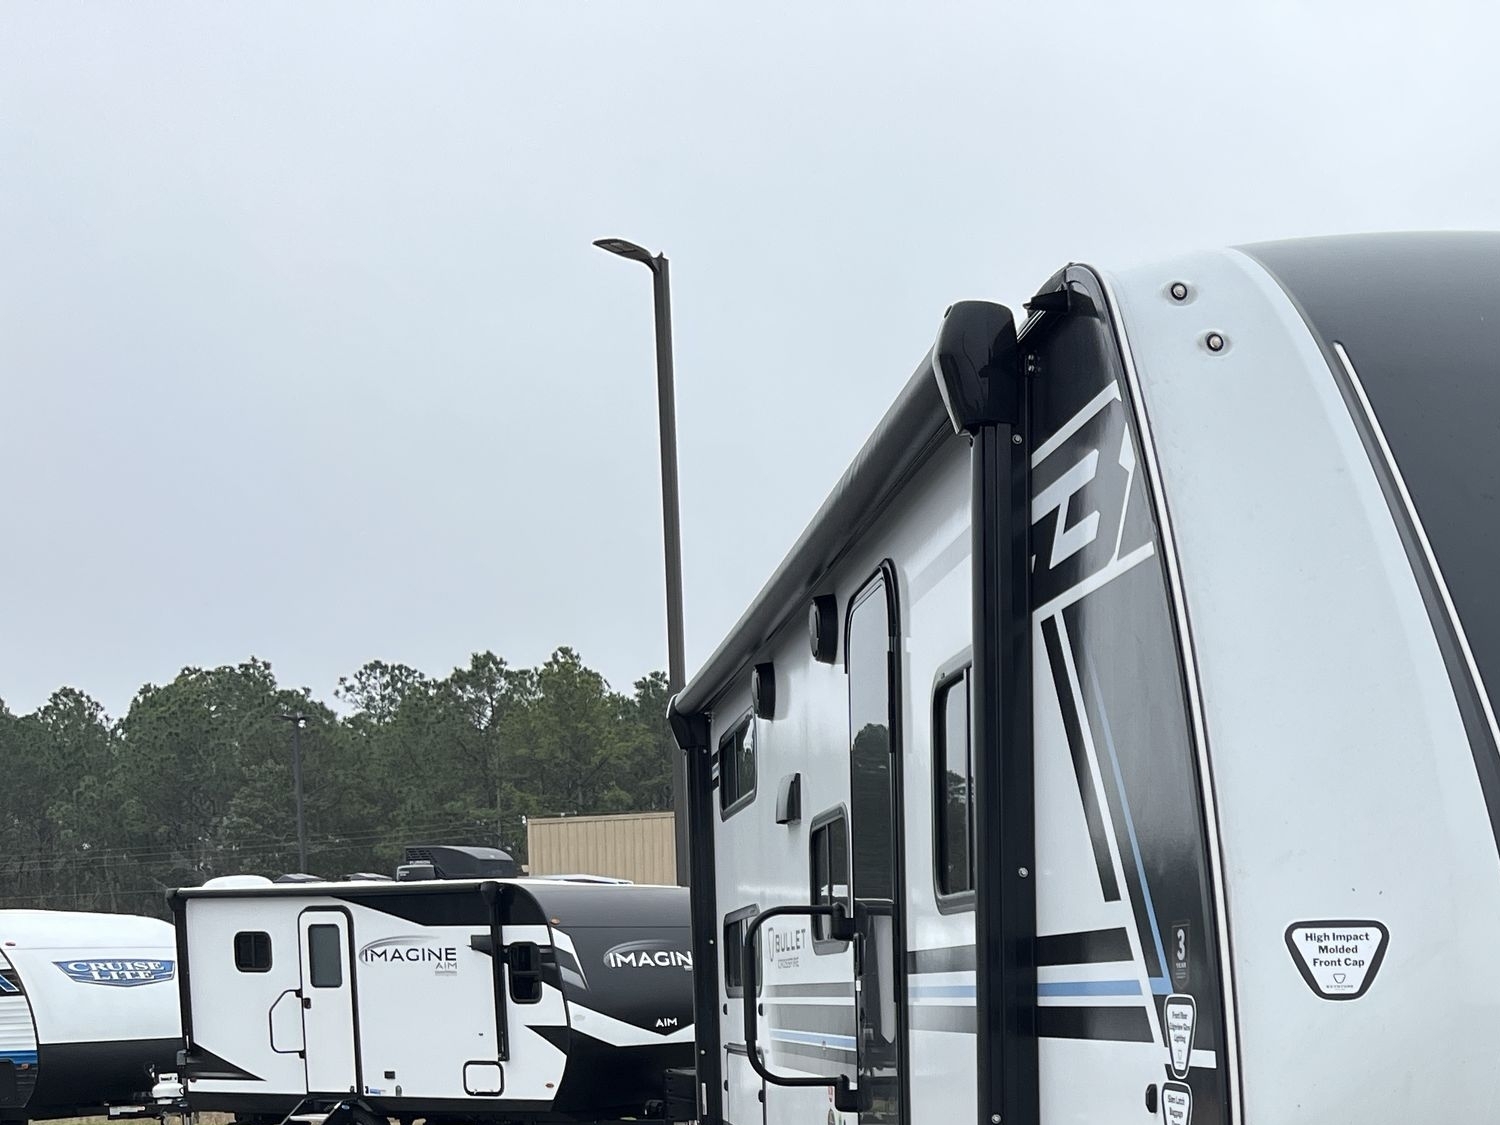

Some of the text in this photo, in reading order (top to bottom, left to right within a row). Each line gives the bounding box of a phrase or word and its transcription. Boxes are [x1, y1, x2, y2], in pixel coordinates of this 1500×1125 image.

[775, 929, 806, 953] BULLET
[1304, 932, 1370, 942] High Impact
[1176, 928, 1186, 961] 3
[1318, 945, 1359, 954] Molded
[363, 947, 457, 962] IMAGINE
[68, 961, 165, 972] CRUISE
[435, 962, 458, 970] AIM
[1312, 958, 1366, 968] Front Cap
[92, 970, 155, 981] LITE
[655, 1017, 678, 1028] AIM
